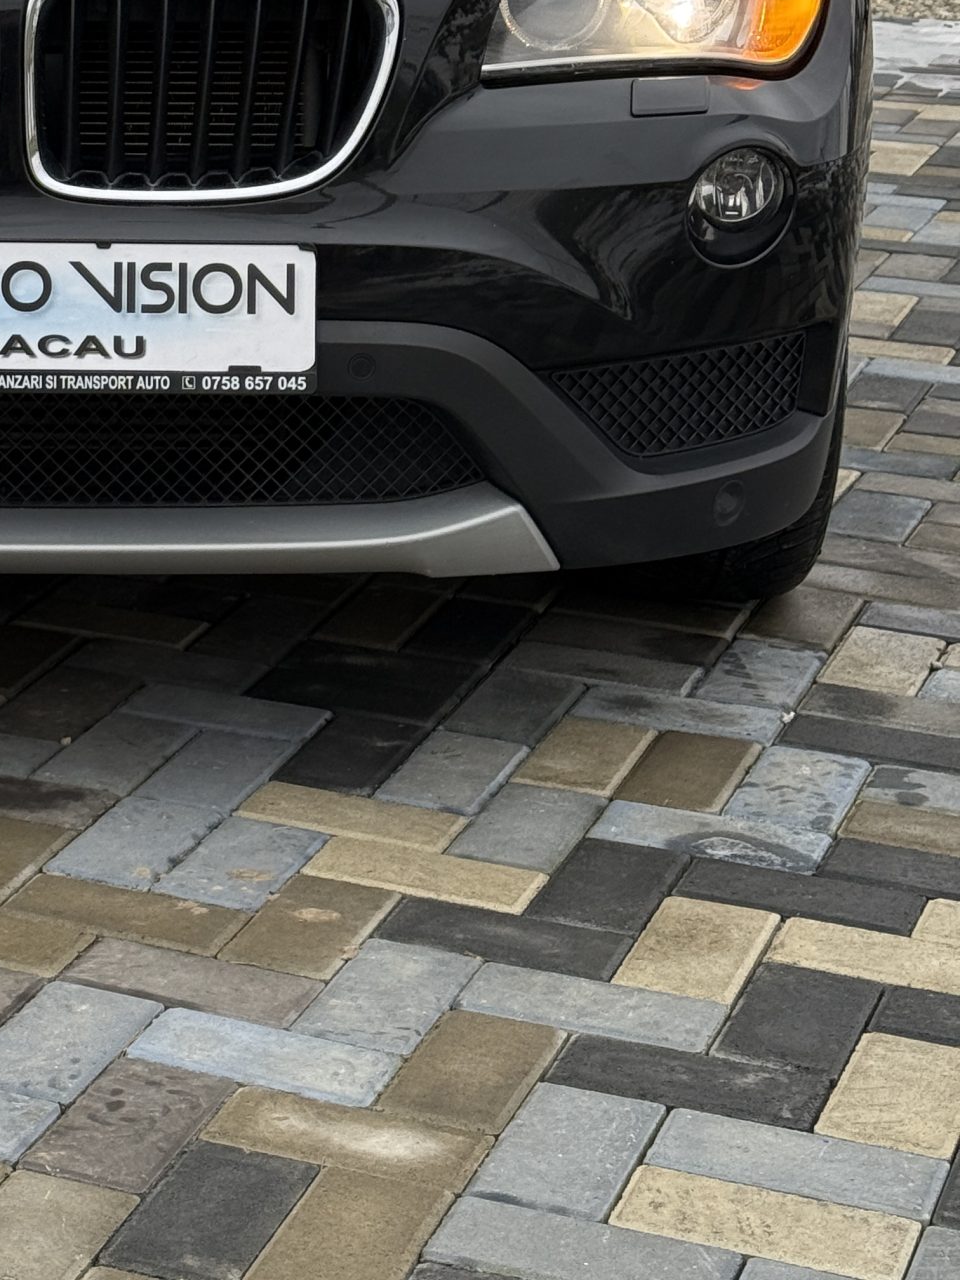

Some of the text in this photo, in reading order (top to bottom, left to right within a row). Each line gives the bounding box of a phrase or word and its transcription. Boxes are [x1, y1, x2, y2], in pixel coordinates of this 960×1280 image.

[69, 260, 296, 315] VISION
[46, 375, 57, 389] SI
[60, 375, 133, 390] TRANSPORT
[136, 375, 170, 390] AUTO
[202, 376, 240, 390] 0758
[244, 376, 273, 390] 657
[278, 376, 307, 390] 045
